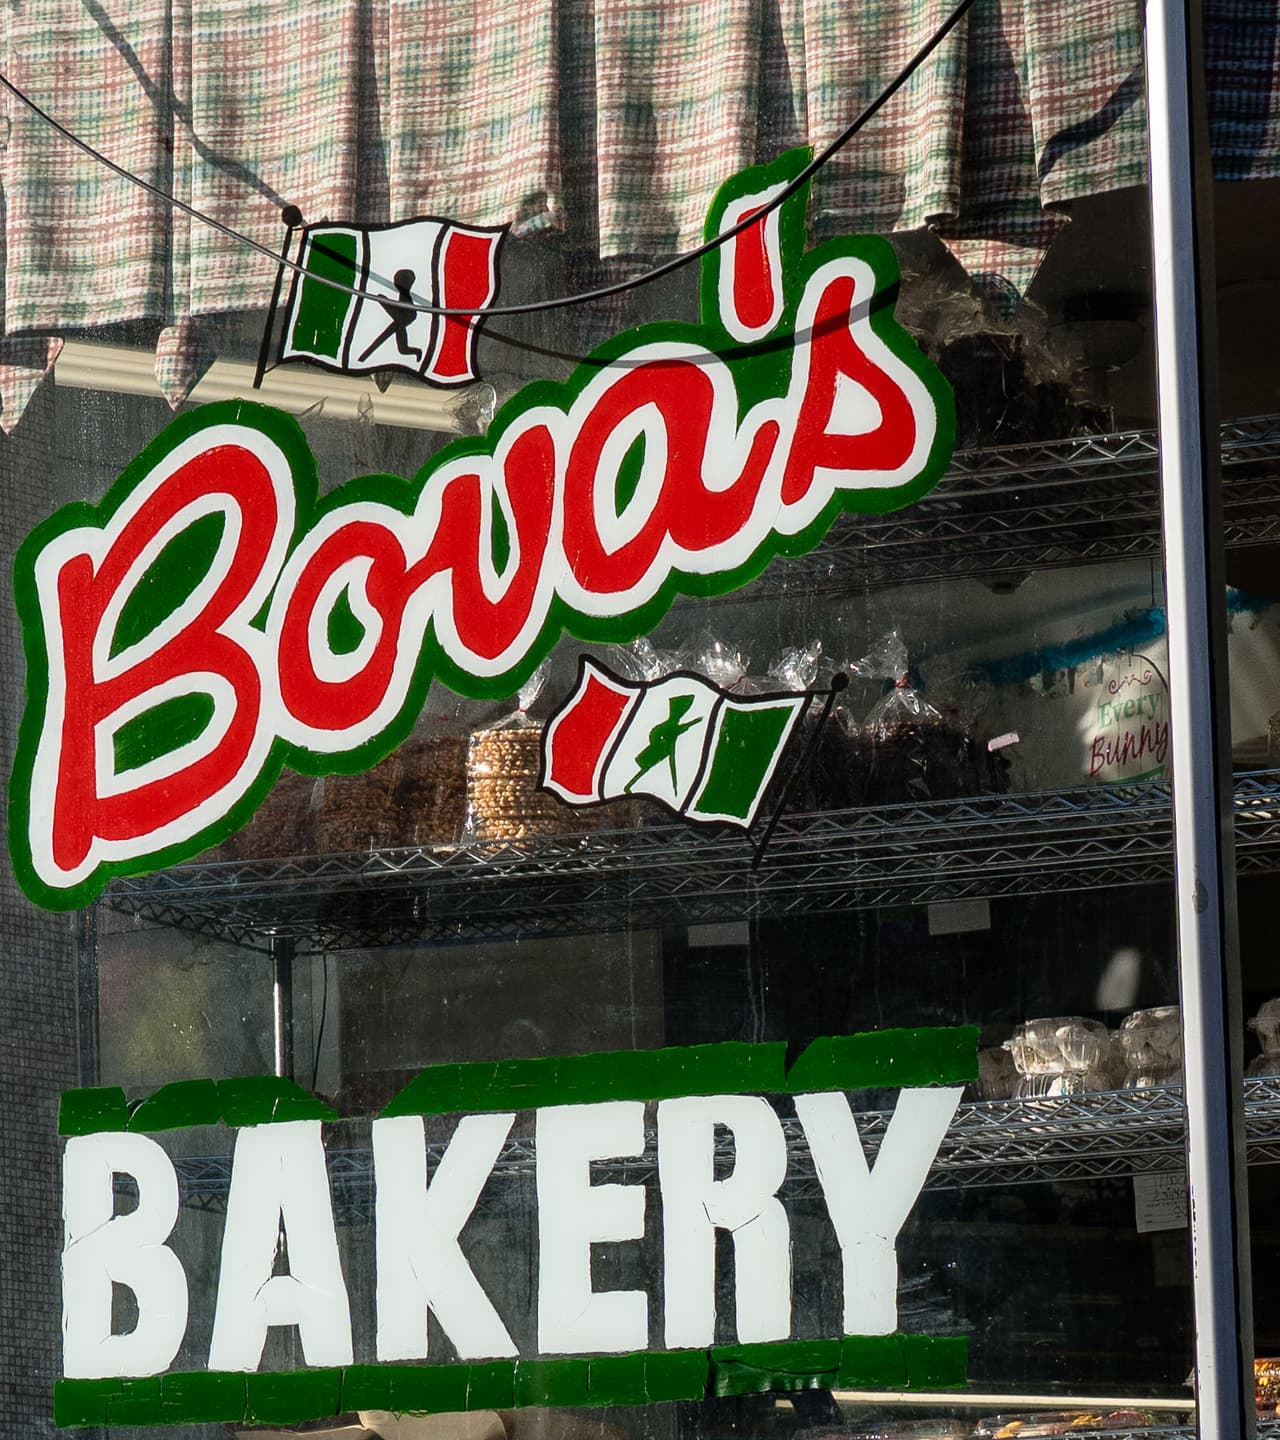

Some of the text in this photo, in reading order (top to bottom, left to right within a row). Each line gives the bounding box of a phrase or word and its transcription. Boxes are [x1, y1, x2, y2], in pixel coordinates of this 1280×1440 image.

[23, 178, 938, 890] Bova's
[1090, 722, 1169, 777] Bunny
[1100, 692, 1160, 729] Every
[62, 1086, 976, 1380] BAKERY
